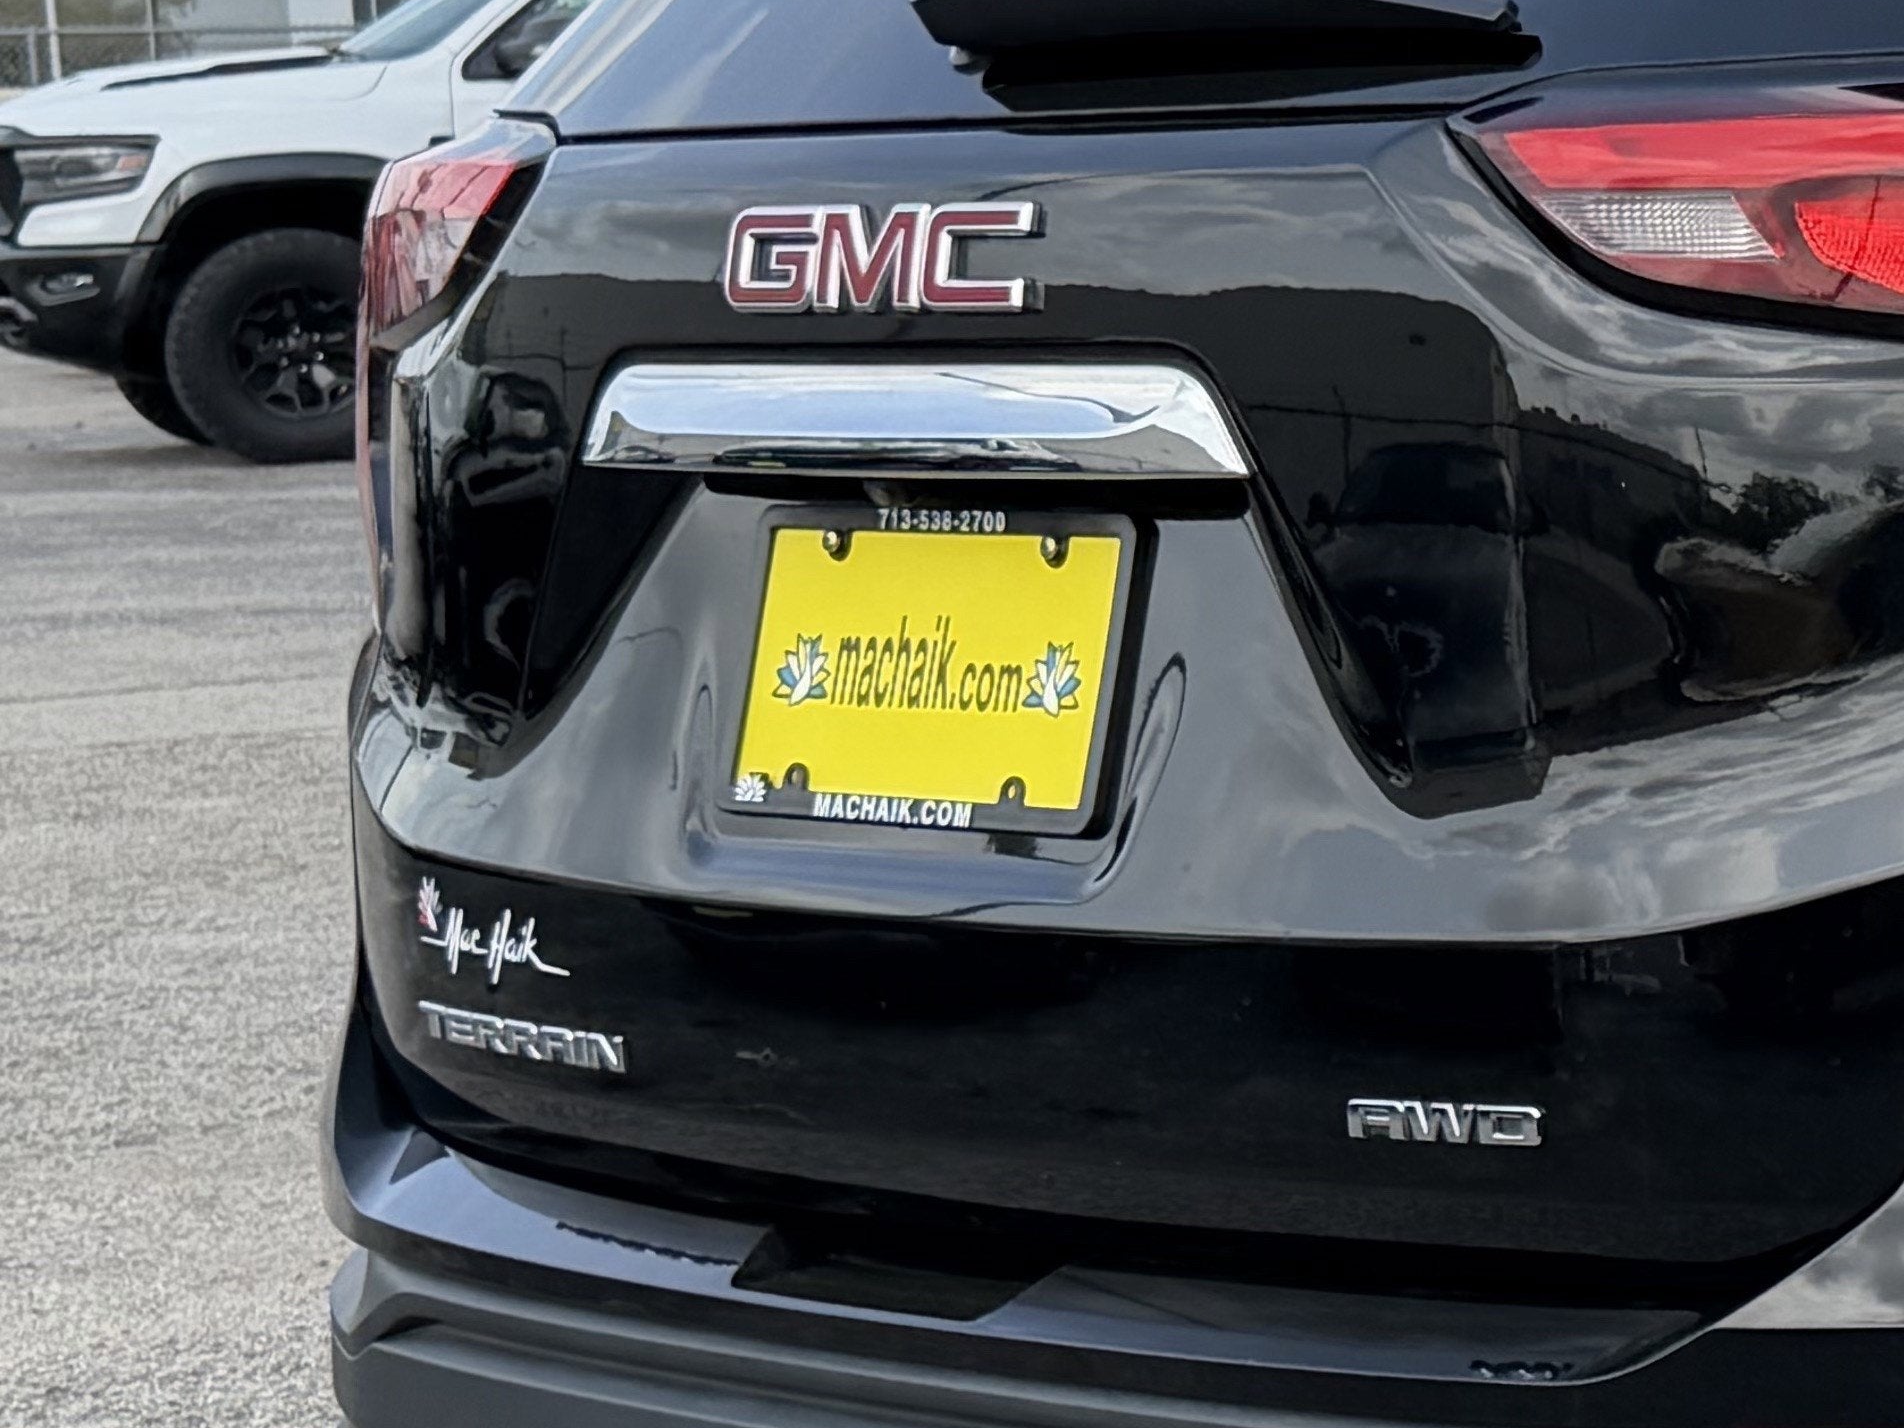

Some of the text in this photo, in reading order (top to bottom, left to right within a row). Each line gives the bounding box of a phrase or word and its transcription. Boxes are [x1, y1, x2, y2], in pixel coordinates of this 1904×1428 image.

[725, 202, 1036, 312] GMC
[878, 508, 1006, 532] 713-538-2700
[830, 615, 1023, 712] machaik.com
[813, 794, 972, 828] MACHAIK.COM
[420, 906, 570, 984] Mac Haik
[418, 1000, 626, 1073] TERRAIN
[1347, 1098, 1542, 1146] AWD
